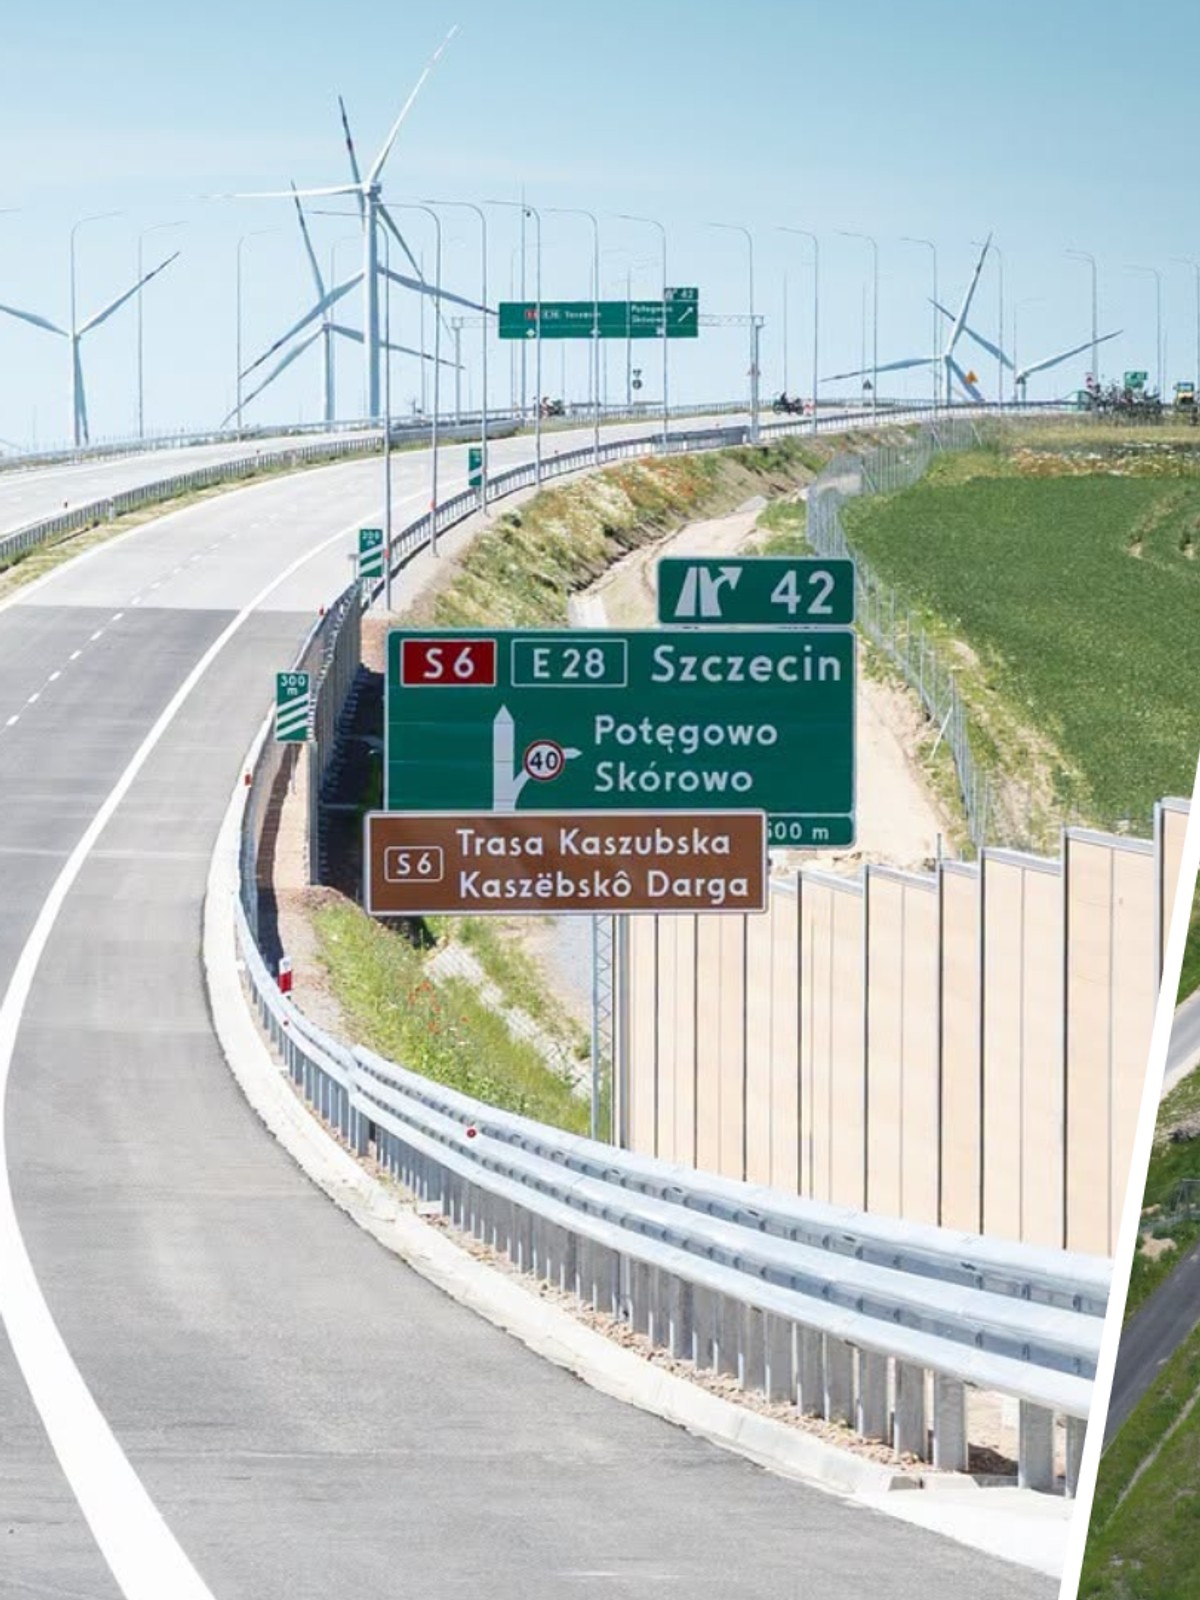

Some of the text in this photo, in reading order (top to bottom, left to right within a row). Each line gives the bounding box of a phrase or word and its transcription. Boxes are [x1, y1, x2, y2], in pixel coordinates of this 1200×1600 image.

[770, 570, 835, 615] 42
[650, 644, 842, 683] Szczecin
[280, 675, 306, 687] 300
[287, 687, 298, 696] m
[594, 714, 779, 754] Potęgowo
[529, 751, 559, 772] 40
[594, 760, 754, 793] Skórowo
[455, 827, 731, 858] Trasa Kaszubska
[812, 826, 830, 841] m
[459, 867, 749, 905] Kaszëbskô Darga
